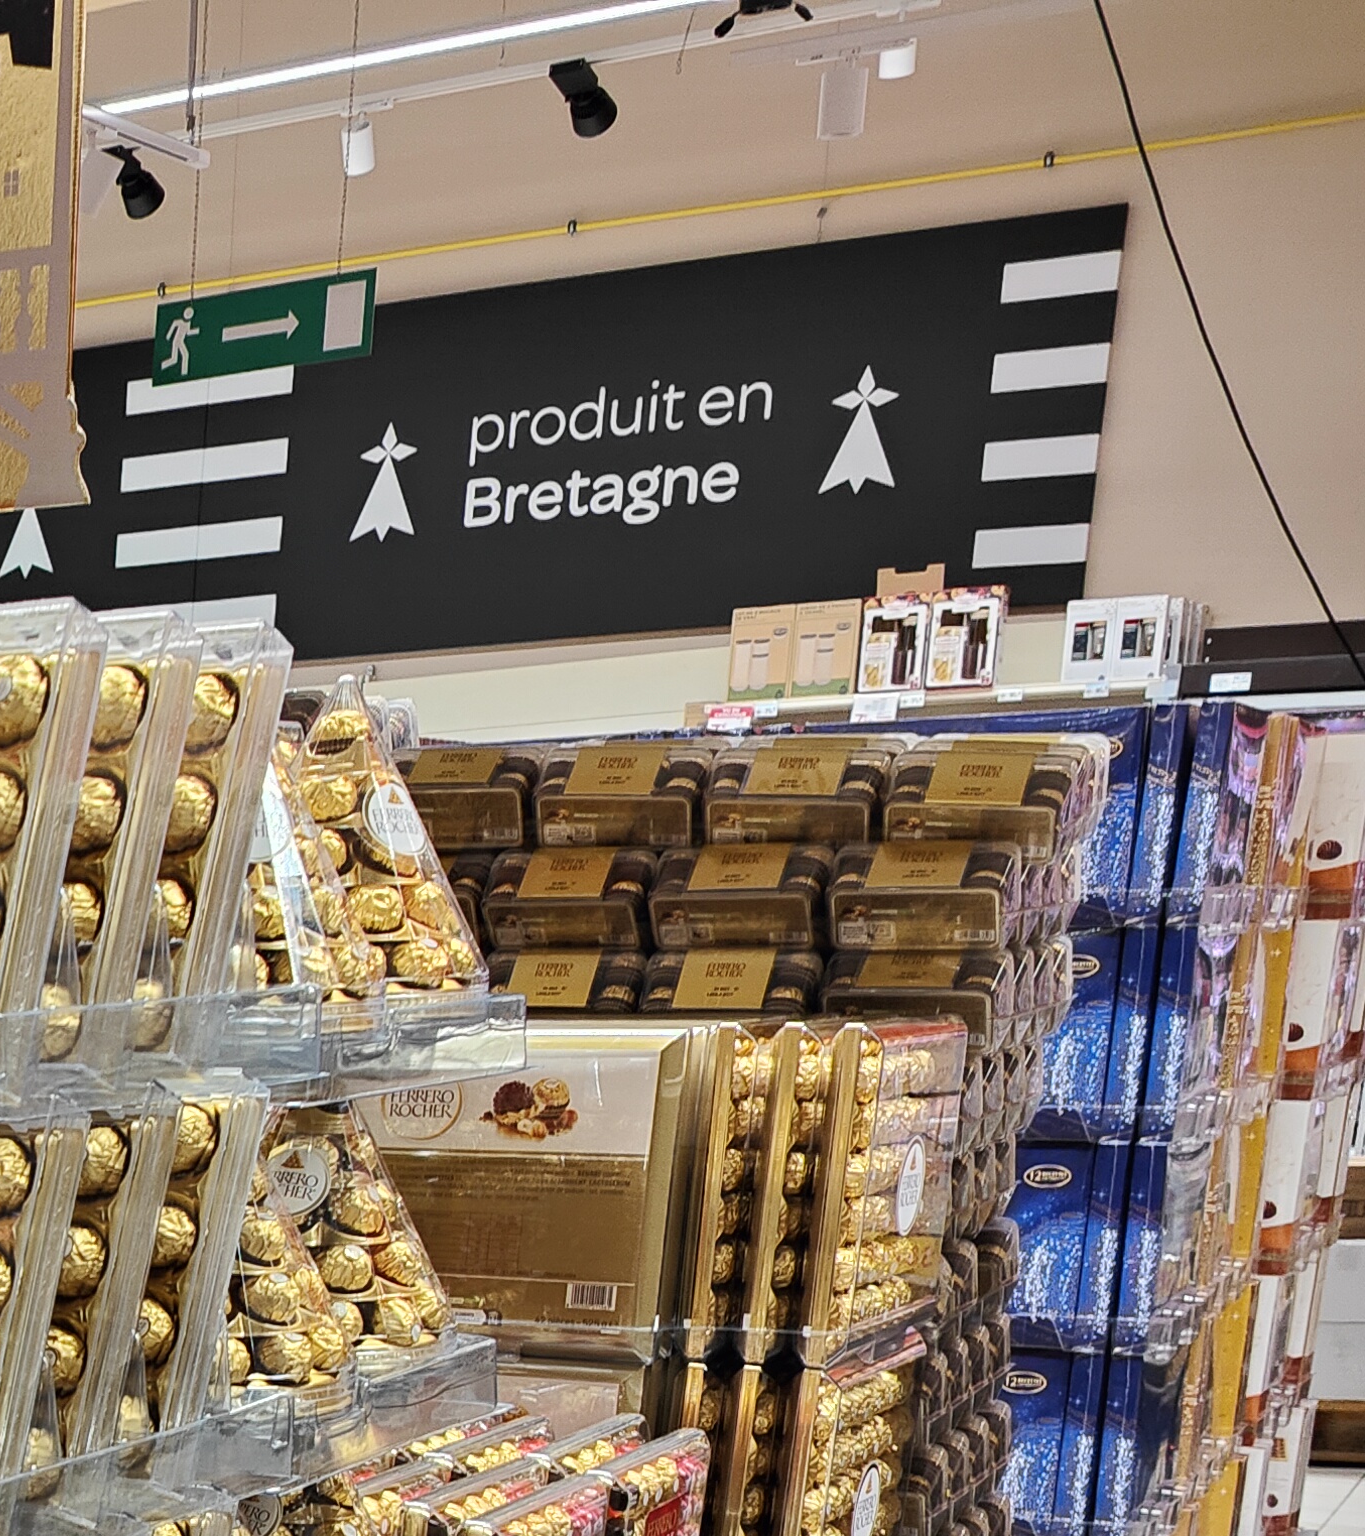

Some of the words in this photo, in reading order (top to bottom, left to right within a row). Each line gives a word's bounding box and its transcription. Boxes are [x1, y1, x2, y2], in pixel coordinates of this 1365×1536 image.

[468, 379, 687, 467] produit
[698, 380, 773, 426] en
[463, 461, 740, 528] Bretagne
[389, 1102, 452, 1118] ROCHER
